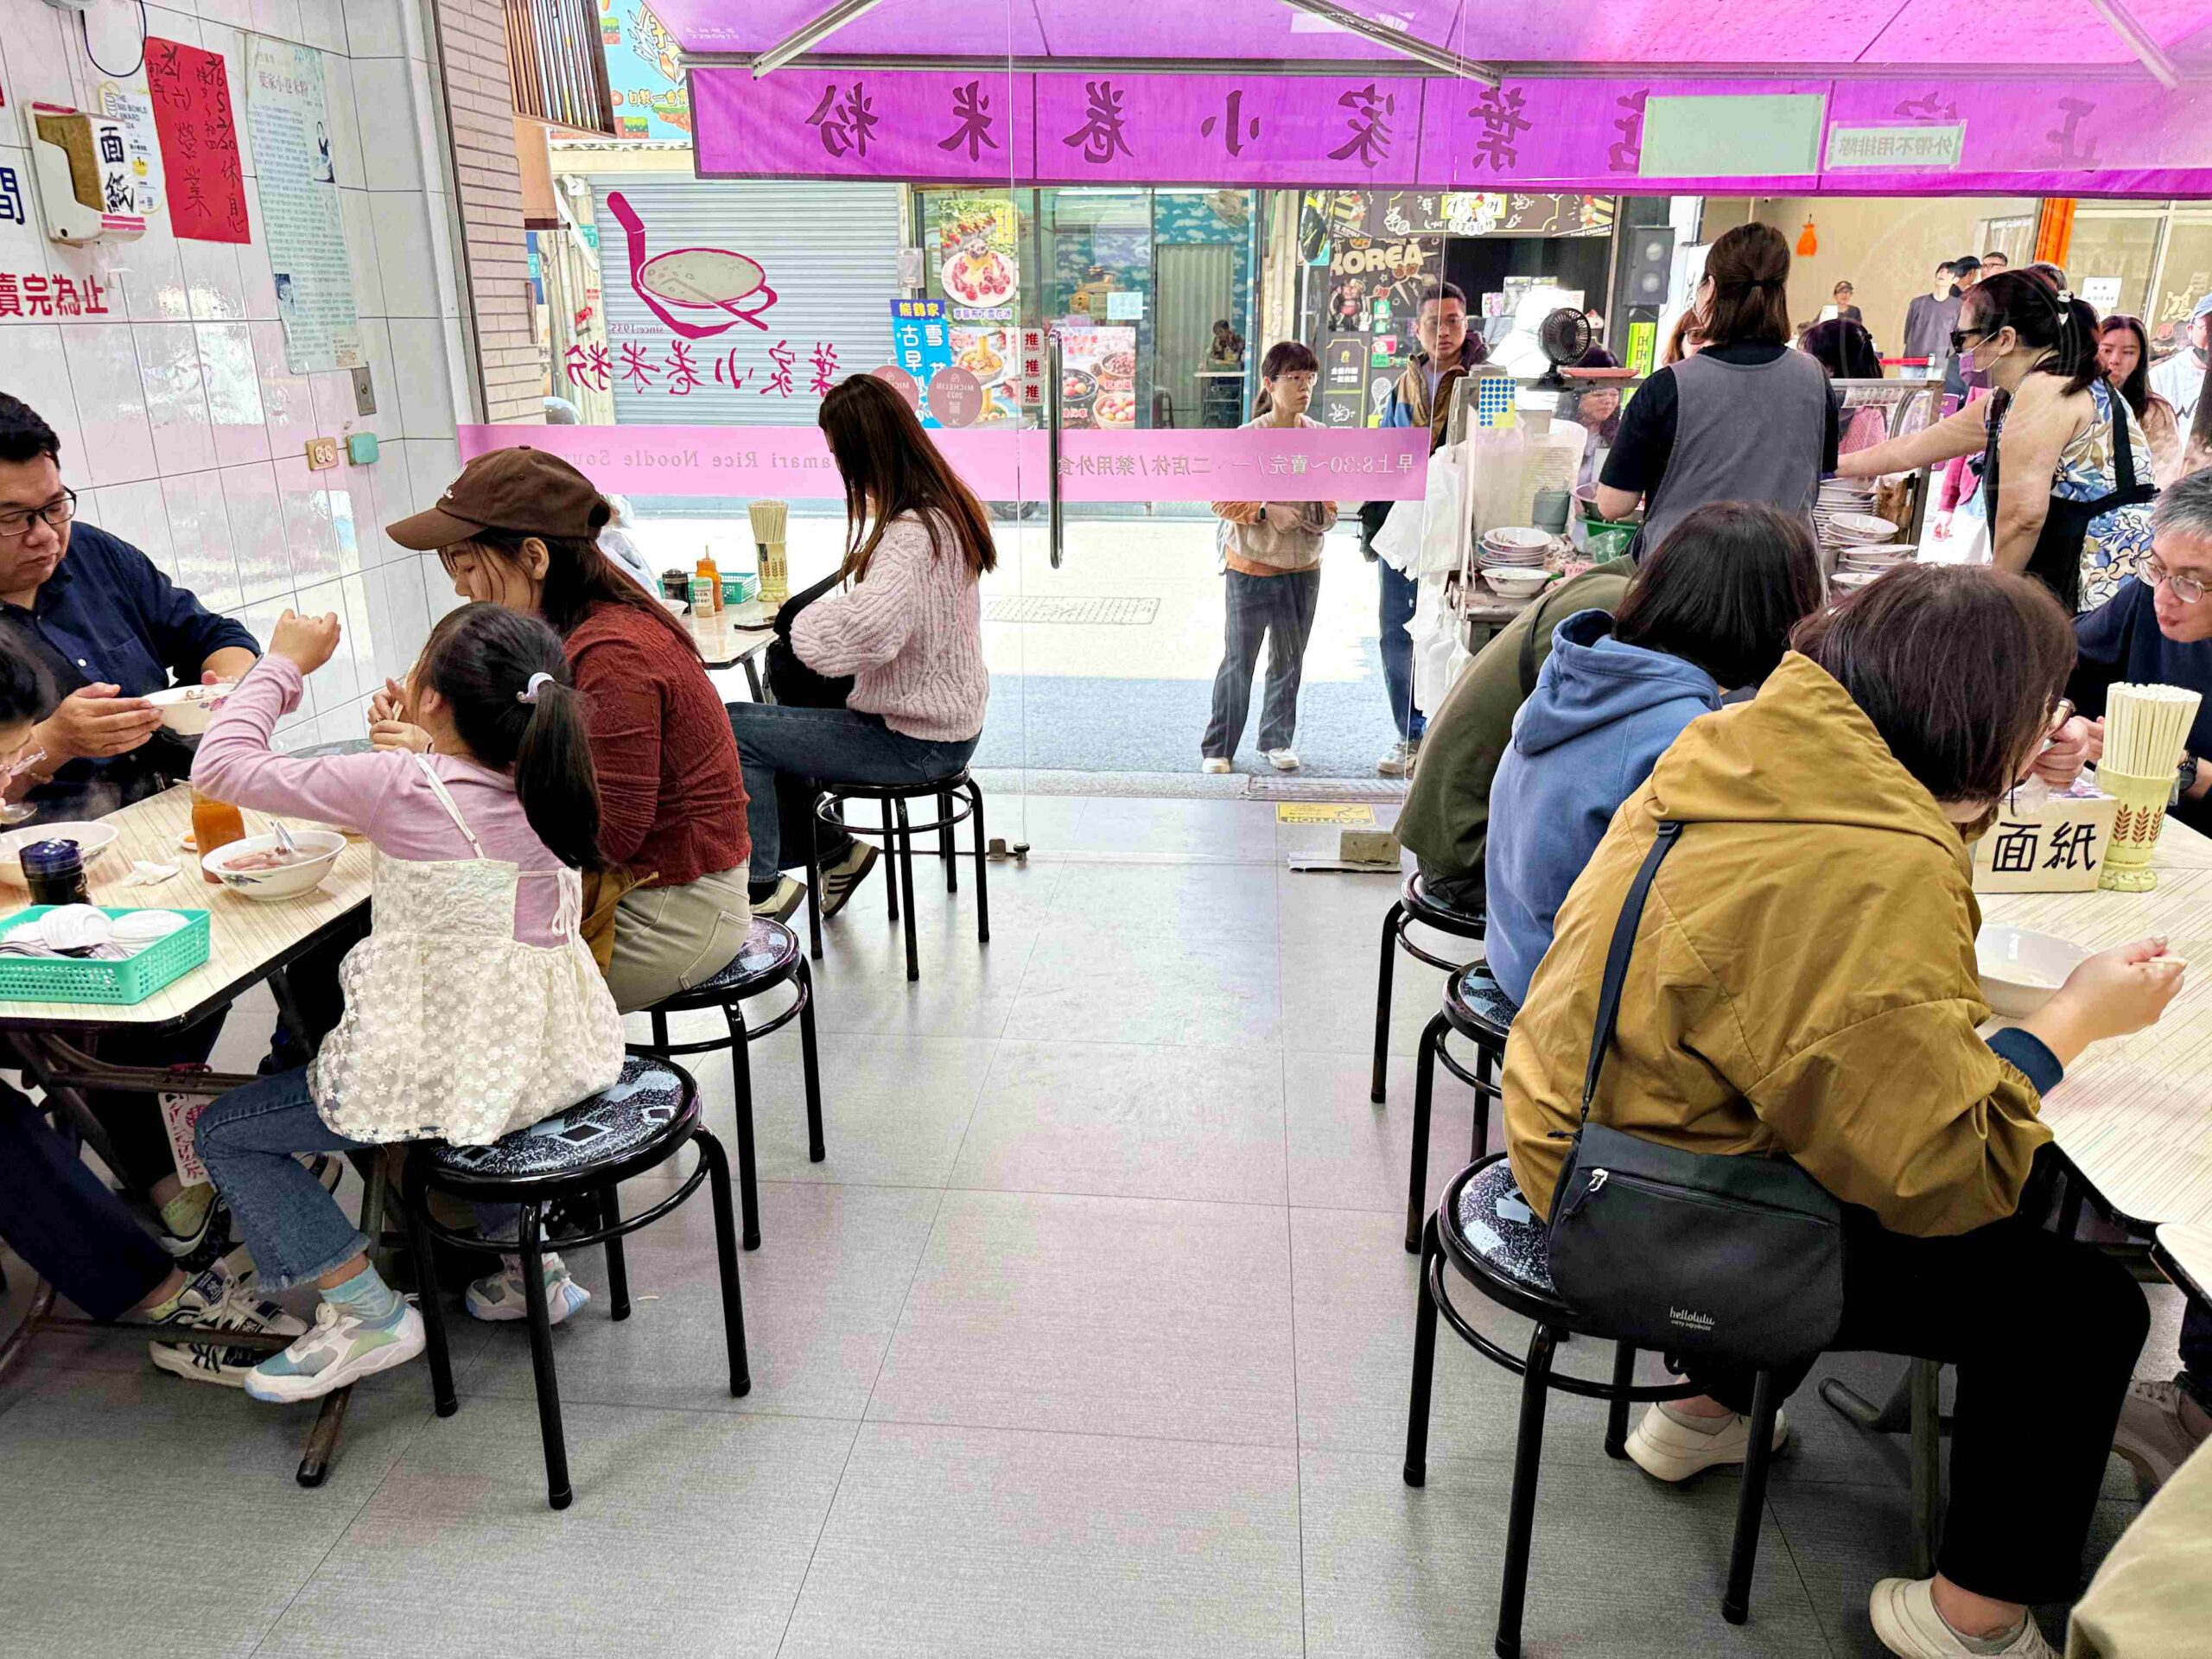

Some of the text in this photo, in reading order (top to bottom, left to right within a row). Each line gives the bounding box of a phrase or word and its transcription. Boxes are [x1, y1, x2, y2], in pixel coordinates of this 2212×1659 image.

[1331, 244, 1424, 276] KOREA
[1025, 333, 1039, 346] 推
[1025, 359, 1039, 372] 推
[1025, 385, 1039, 397] 推
[1992, 821, 2097, 872] 面紙
[1669, 1306, 1715, 1325] hellolulu
